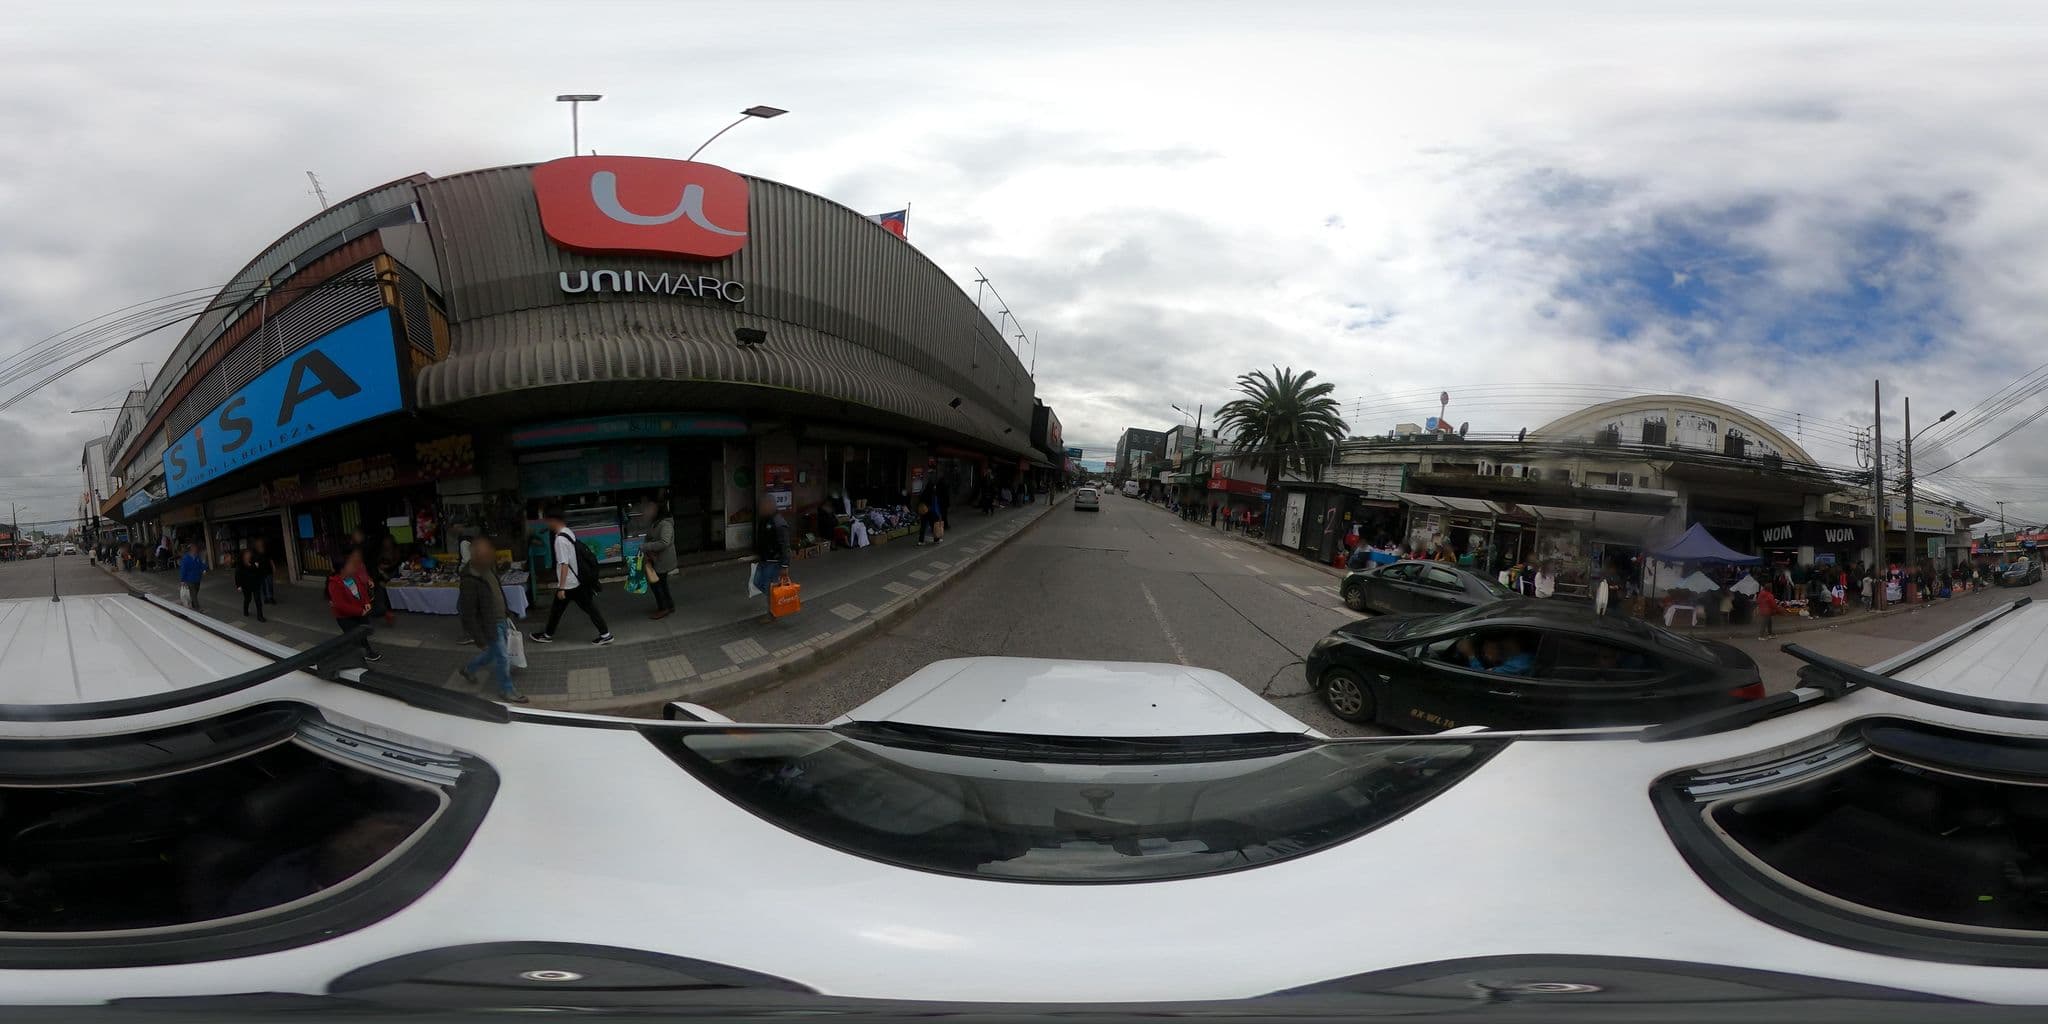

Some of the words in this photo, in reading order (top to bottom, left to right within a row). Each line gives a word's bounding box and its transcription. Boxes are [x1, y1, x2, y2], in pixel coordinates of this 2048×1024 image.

[241, 423, 316, 460] BELLEZA
[1762, 524, 1793, 544] WOM
[1824, 527, 1855, 544] WOM
